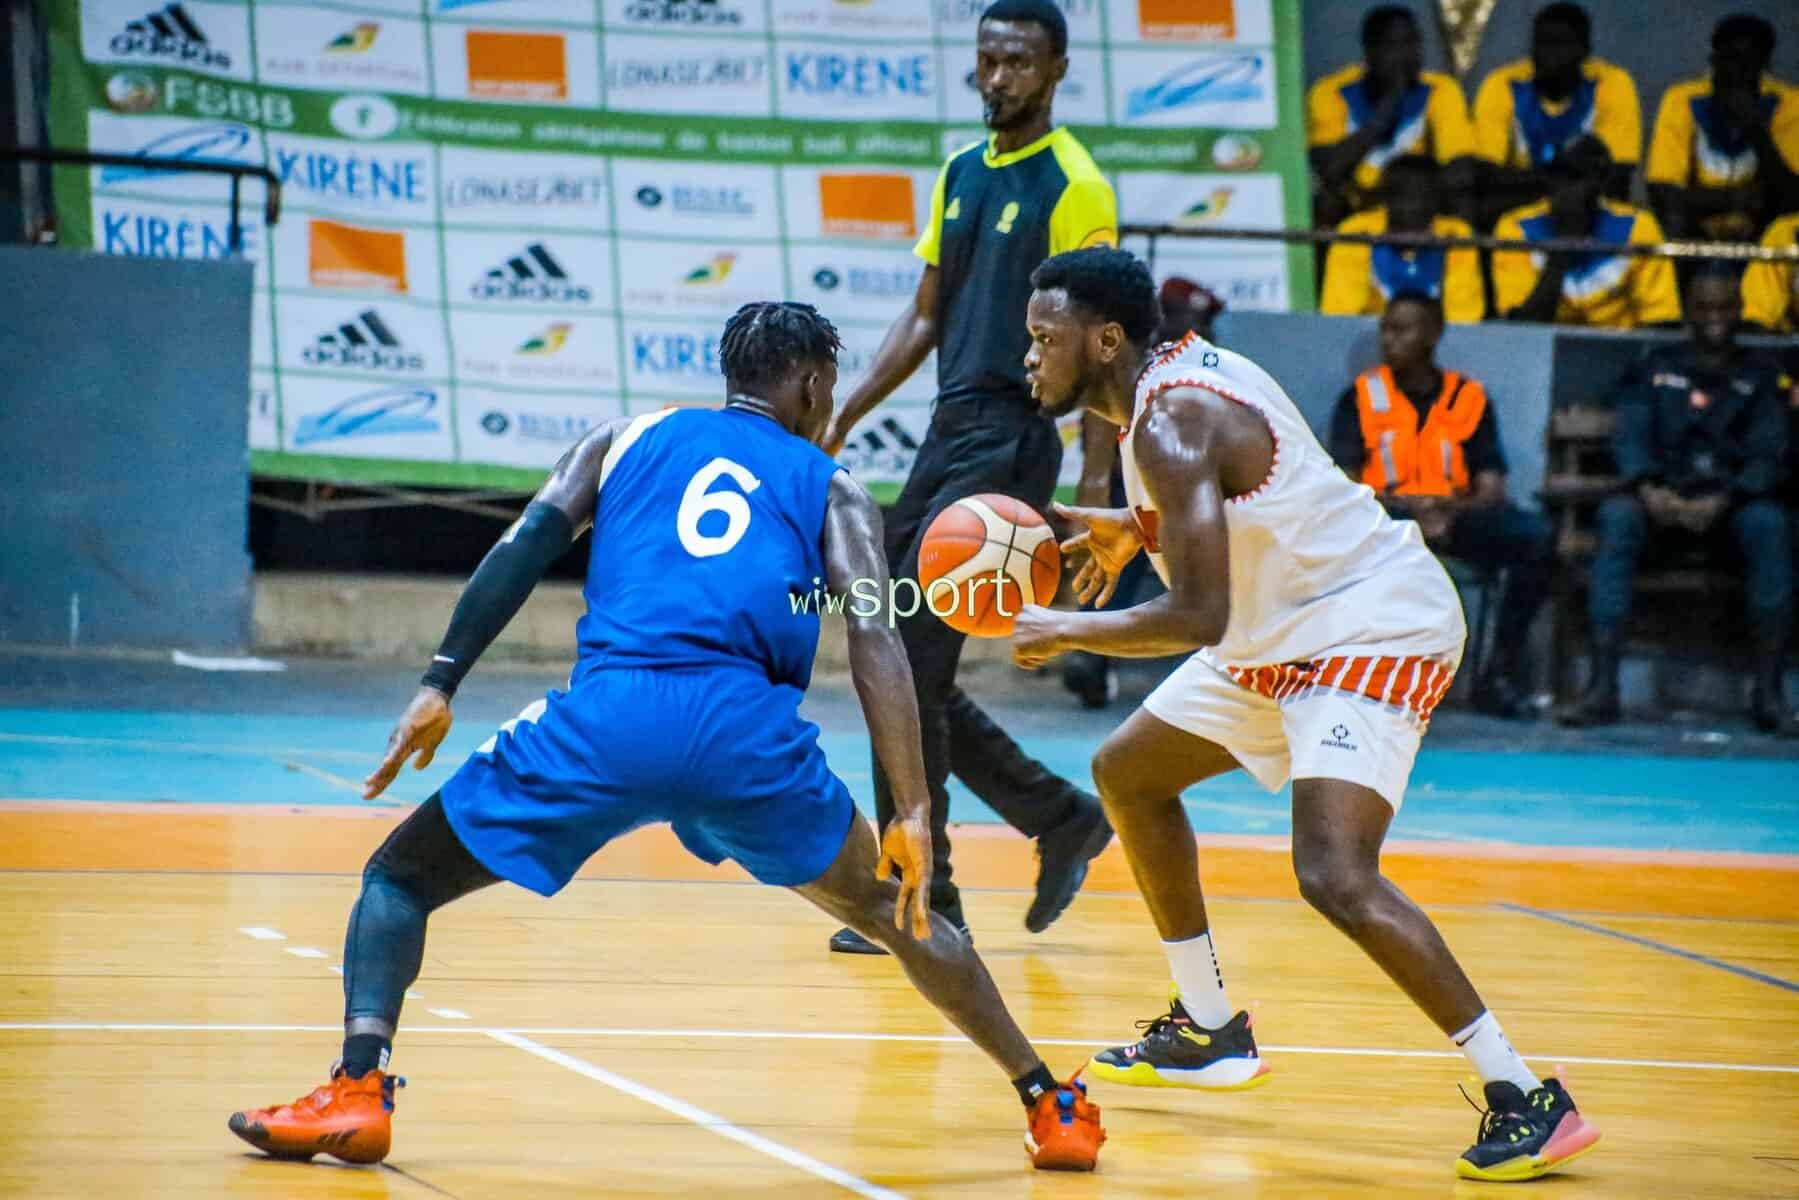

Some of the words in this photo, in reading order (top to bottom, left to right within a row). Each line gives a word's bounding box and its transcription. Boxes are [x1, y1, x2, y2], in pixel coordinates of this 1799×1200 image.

[110, 32, 232, 69] adidas
[470, 282, 593, 301] adidas
[302, 349, 425, 370] adidas
[677, 457, 762, 558] 6
